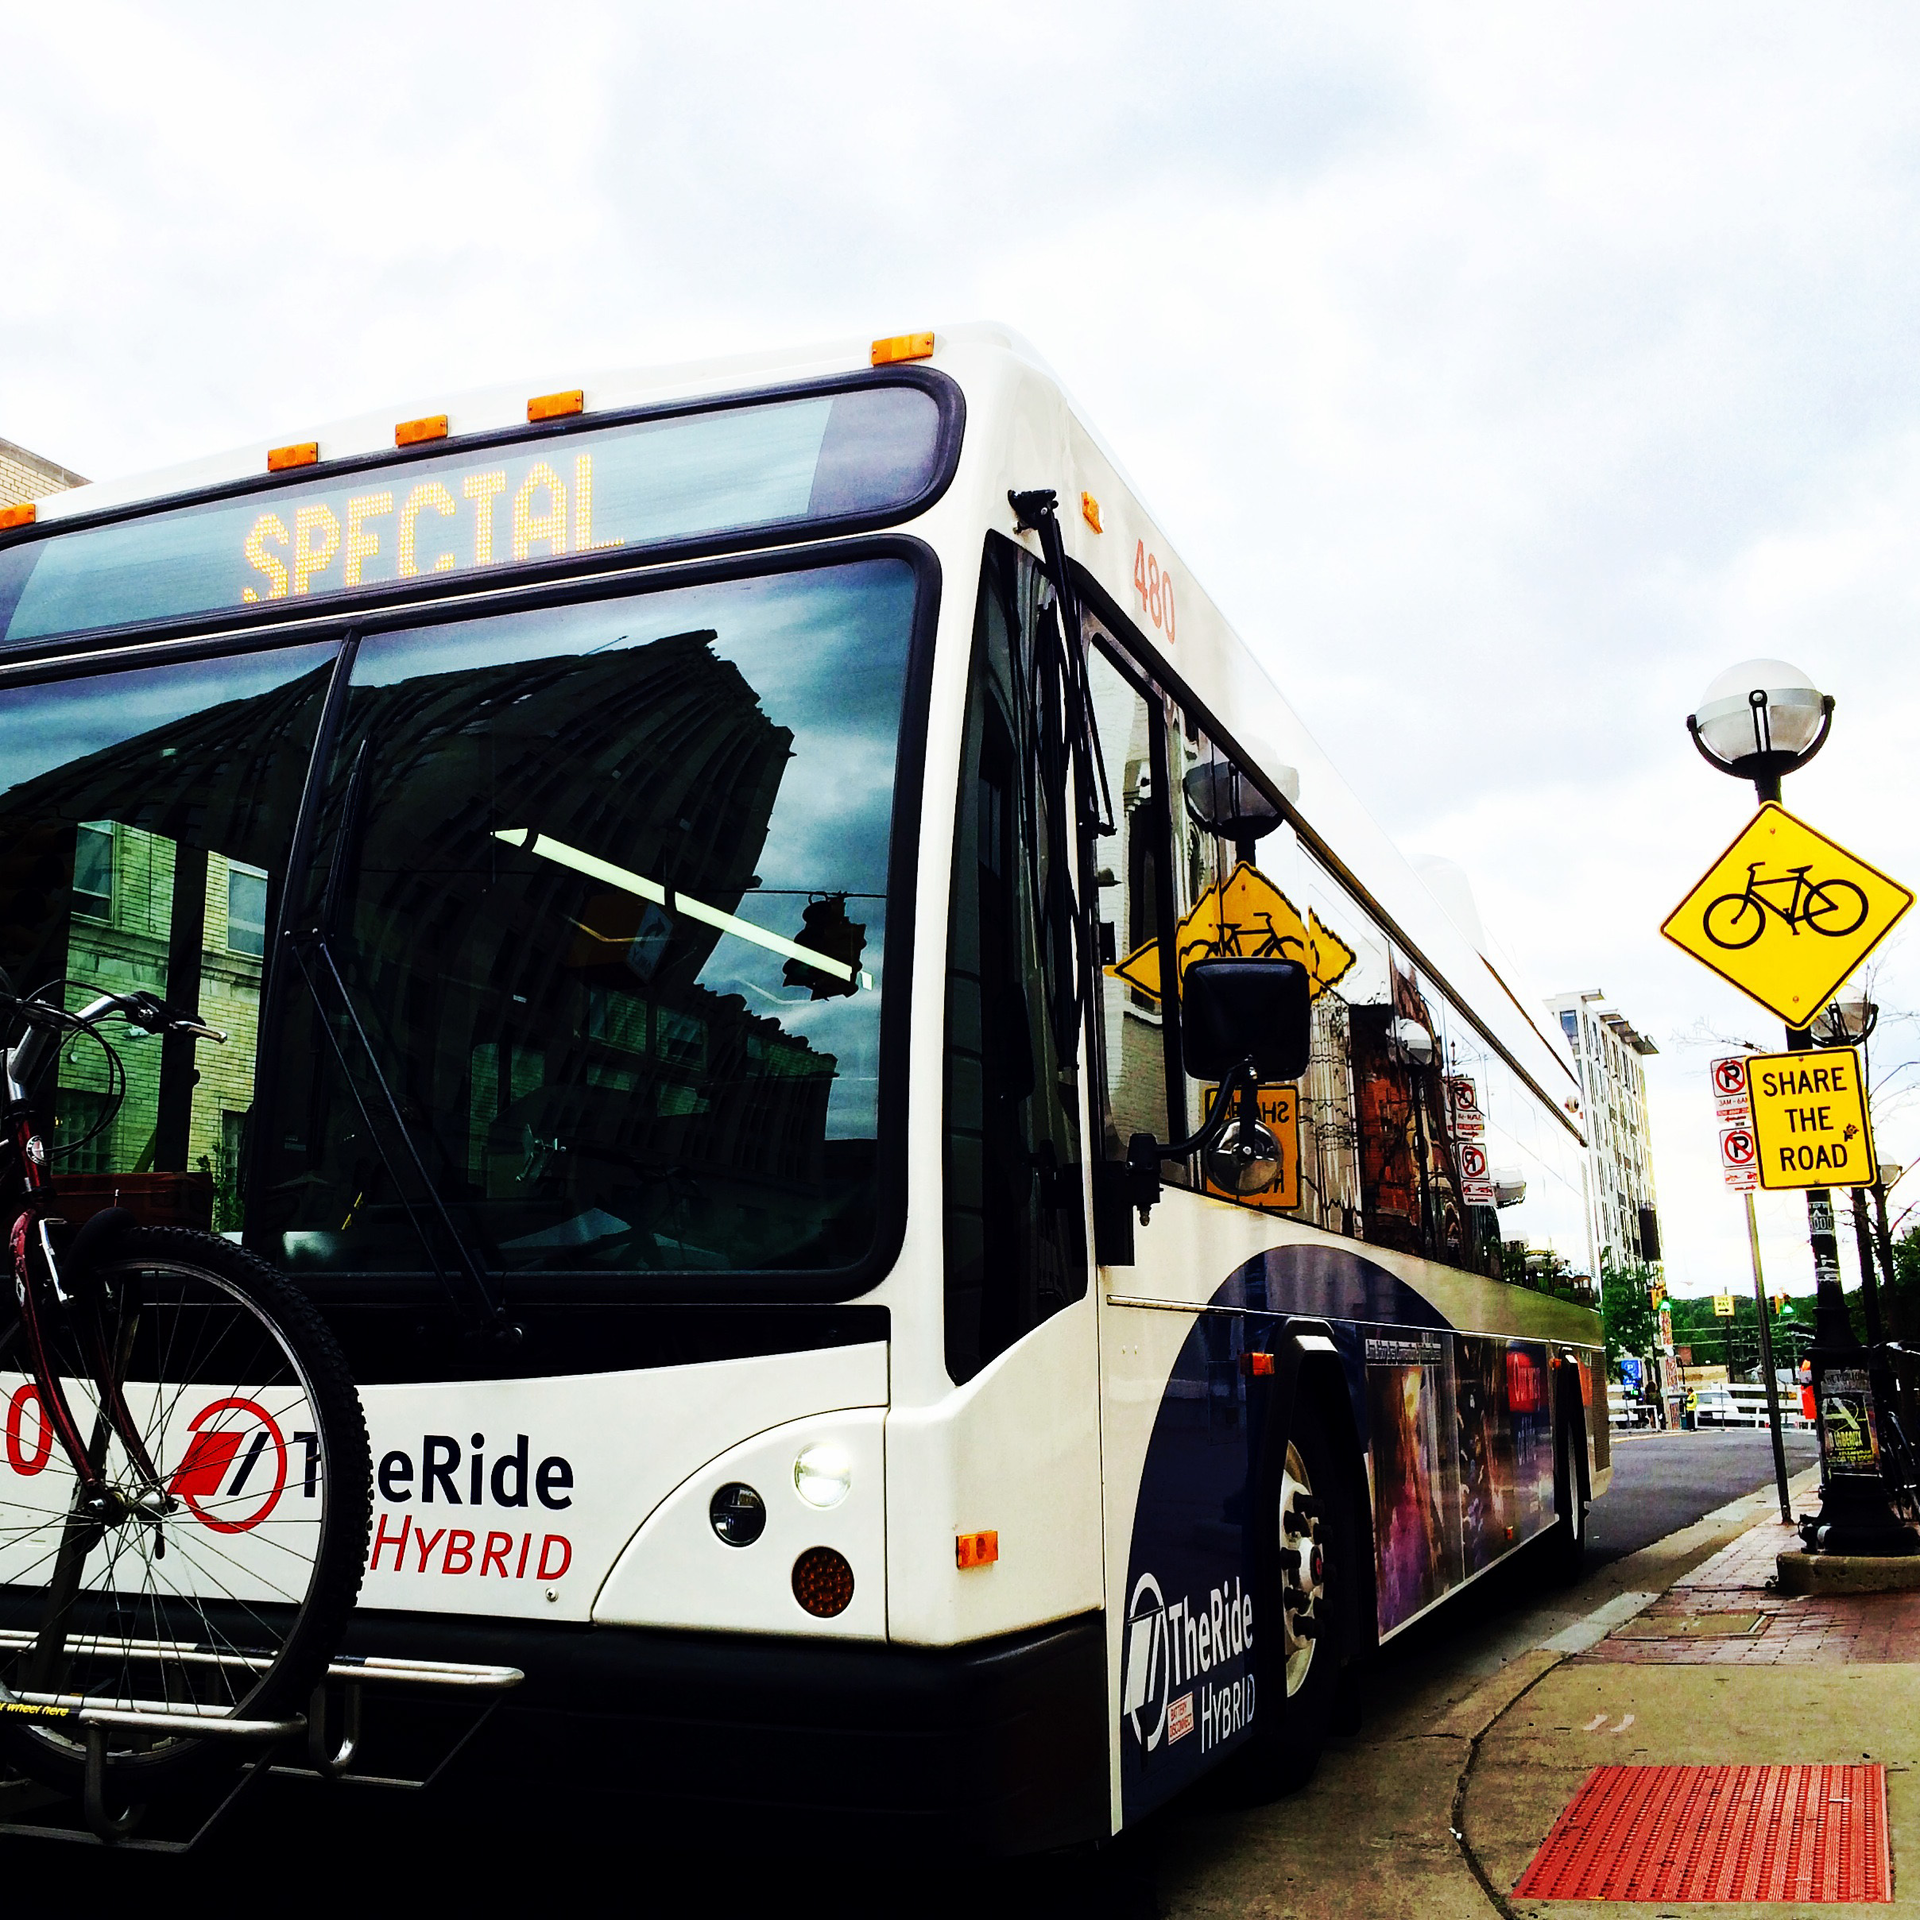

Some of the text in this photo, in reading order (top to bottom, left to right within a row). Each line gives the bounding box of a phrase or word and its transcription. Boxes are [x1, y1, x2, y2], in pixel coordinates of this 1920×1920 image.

[242, 454, 625, 603] SPECIAL
[1134, 541, 1175, 646] 480
[1762, 1066, 1848, 1098] SHARE
[1784, 1106, 1834, 1133] THE
[1779, 1143, 1849, 1172] ROAD
[293, 1431, 574, 1511] TeRide
[370, 1514, 573, 1580] HYBRID
[1168, 1576, 1254, 1686] TheRide
[1201, 1673, 1256, 1754] HYBRID
